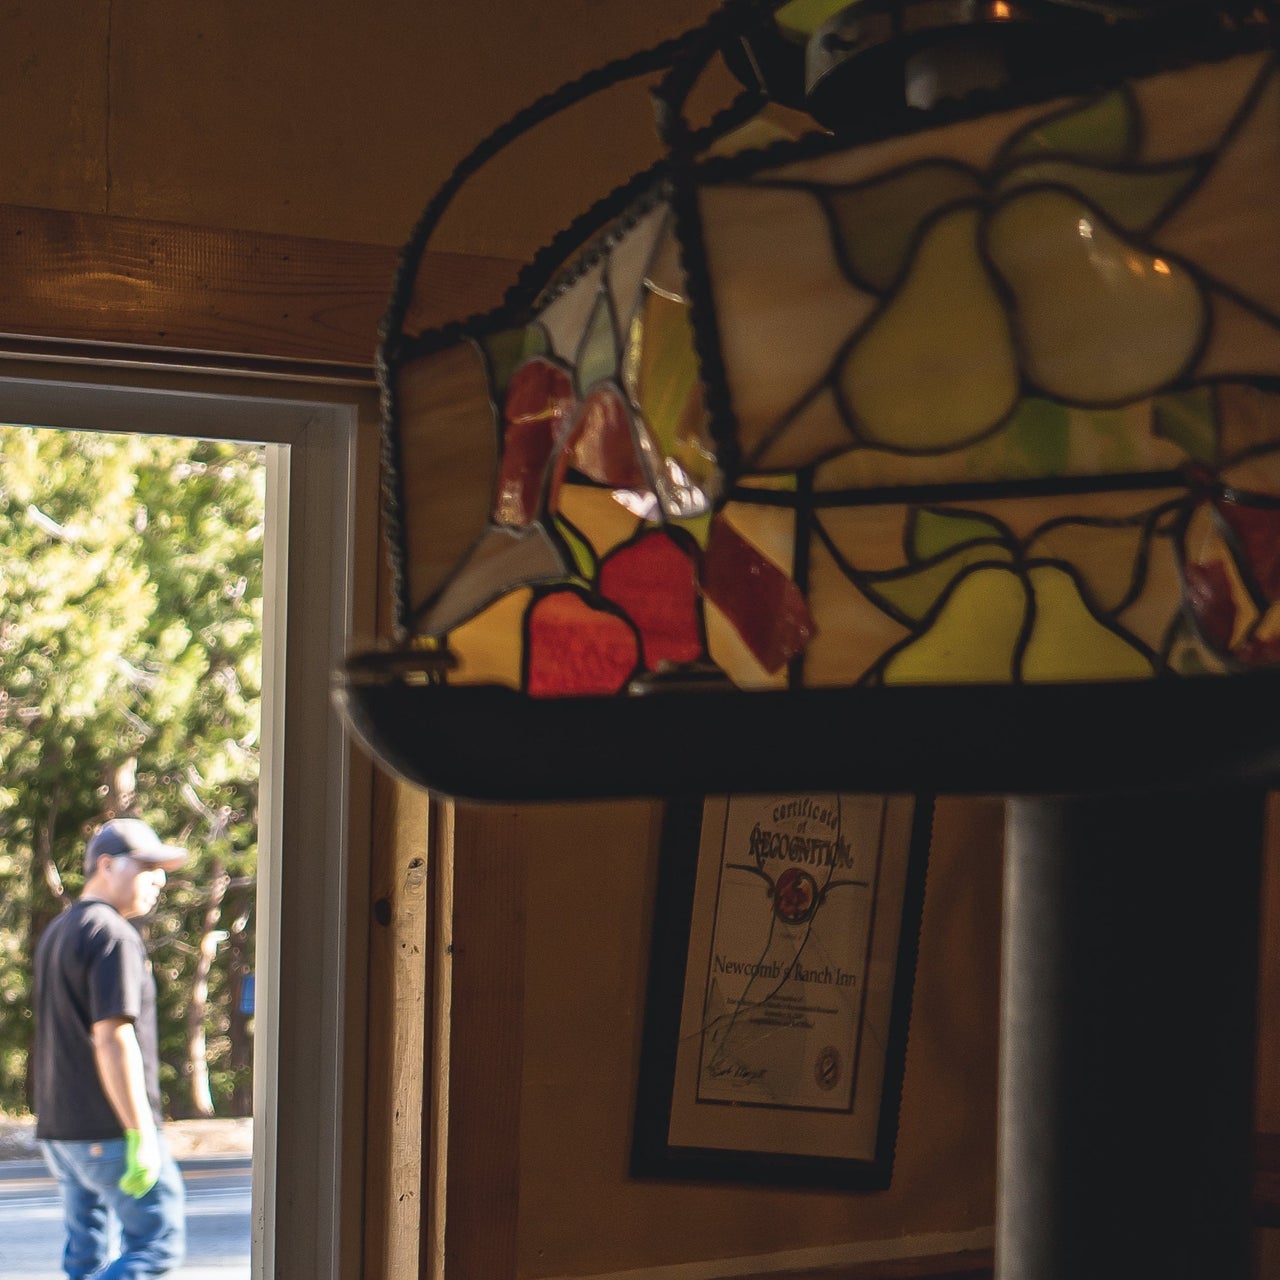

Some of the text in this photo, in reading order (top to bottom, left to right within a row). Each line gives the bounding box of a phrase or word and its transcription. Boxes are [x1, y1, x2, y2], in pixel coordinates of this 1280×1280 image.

[713, 955, 856, 987] Newcomb's Ranch Inn
